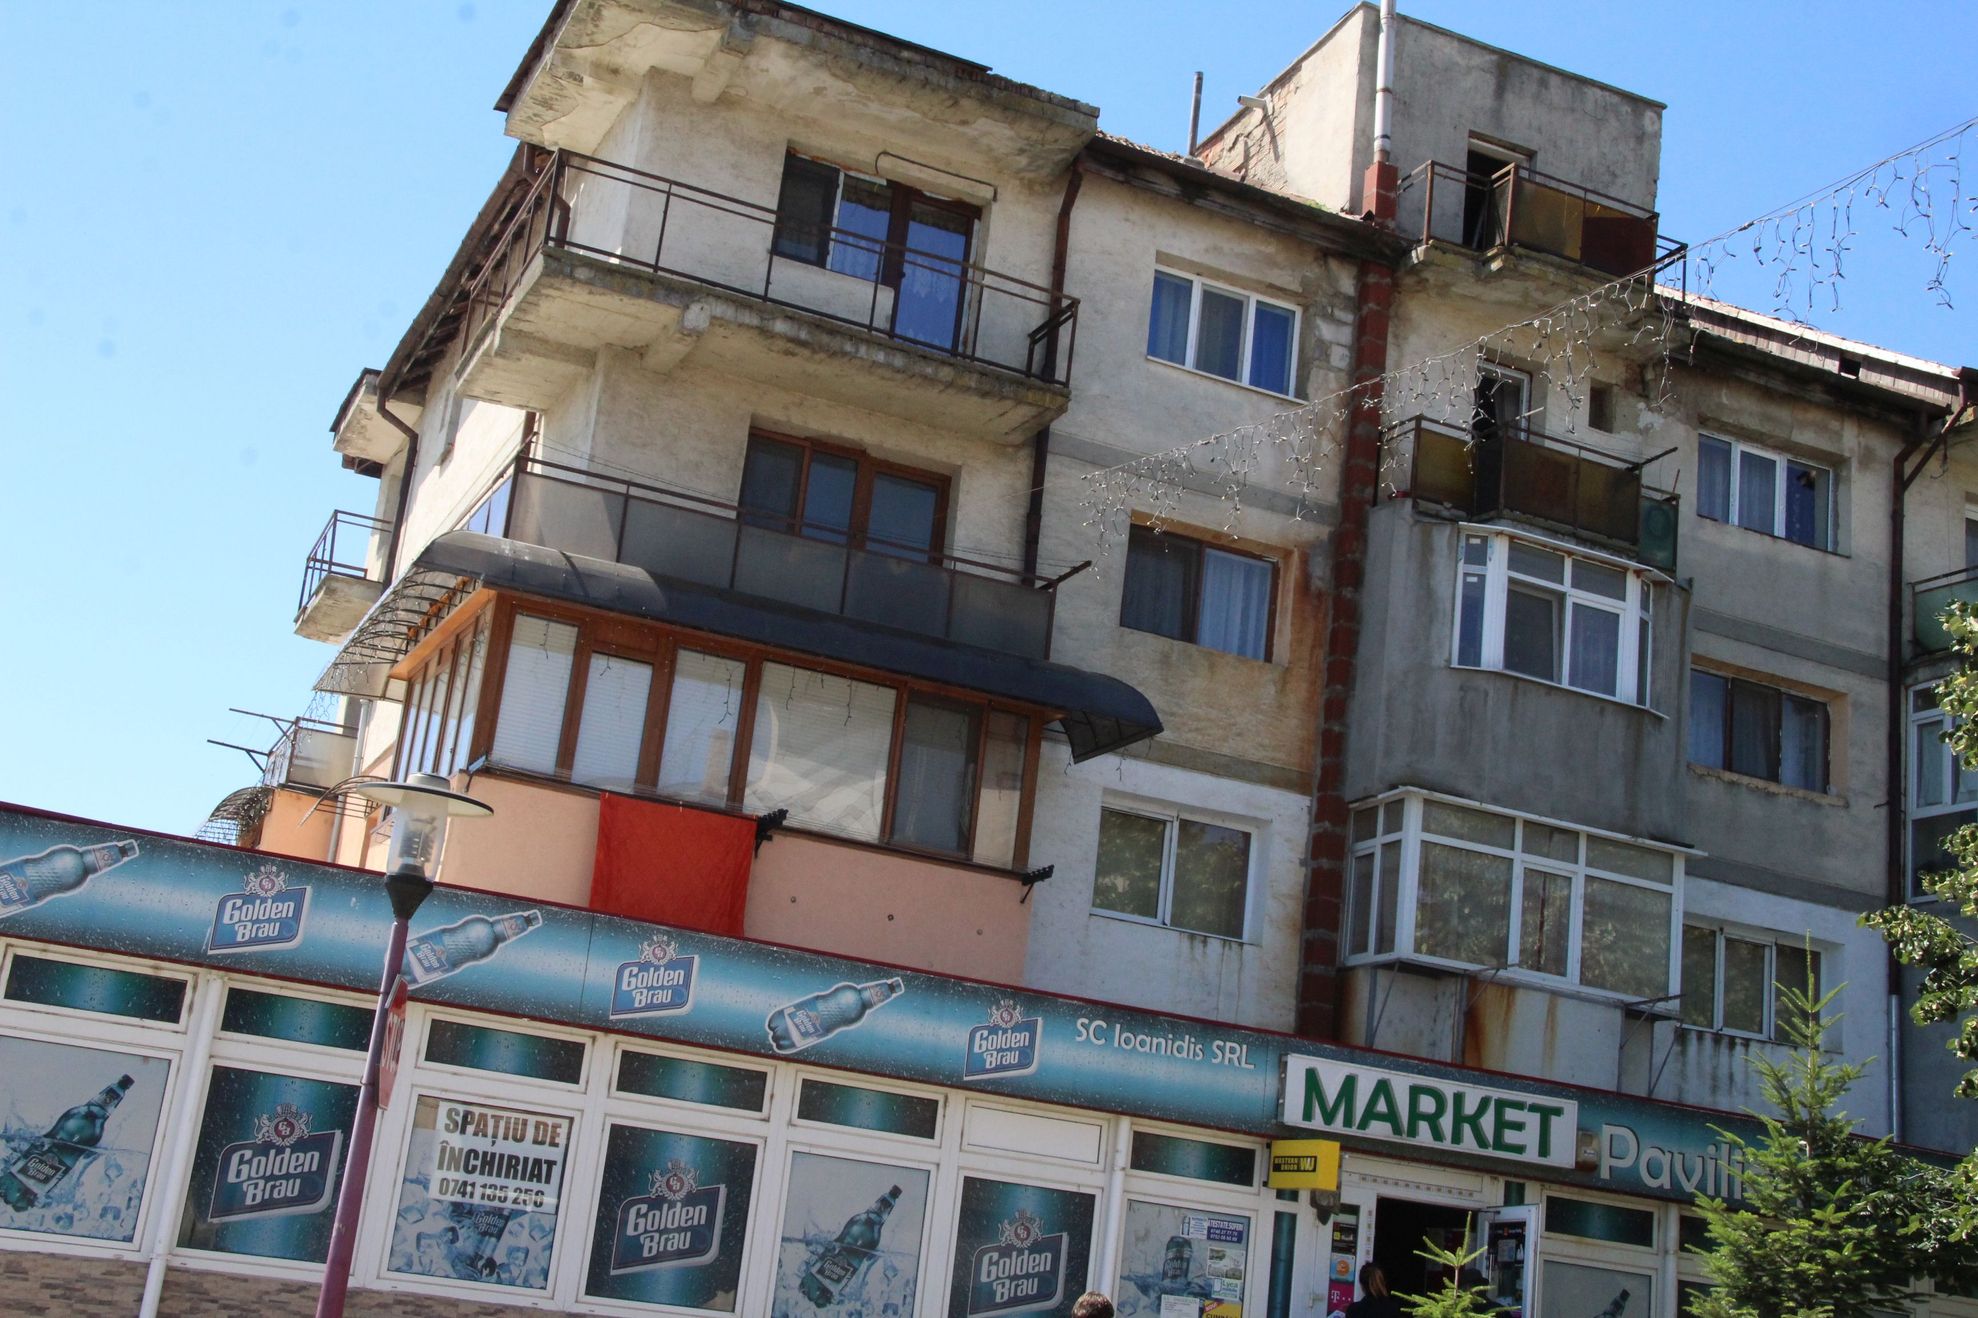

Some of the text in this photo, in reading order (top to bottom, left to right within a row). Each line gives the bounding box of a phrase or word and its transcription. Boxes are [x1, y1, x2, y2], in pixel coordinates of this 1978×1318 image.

[222, 898, 295, 925] Golden
[235, 921, 280, 942] Brau
[622, 966, 684, 991] Golden
[632, 988, 672, 1008] Brau
[973, 1029, 1029, 1053] Golden
[1075, 1018, 1255, 1069] SC Ioanidis SRL
[984, 1050, 1019, 1069] Brau
[1302, 1067, 1564, 1158] MARKET
[532, 1120, 562, 1148] DE
[227, 1147, 320, 1183] Golden
[437, 1140, 557, 1185] ÎNCHIRIAT
[1600, 1123, 1756, 1200] Pavili
[242, 1178, 301, 1206] Brau
[438, 1177, 476, 1199] 0741
[626, 1201, 707, 1237] Golden
[640, 1231, 691, 1258] Brau
[980, 1249, 1052, 1283] Golden
[993, 1277, 1038, 1303] Brau
